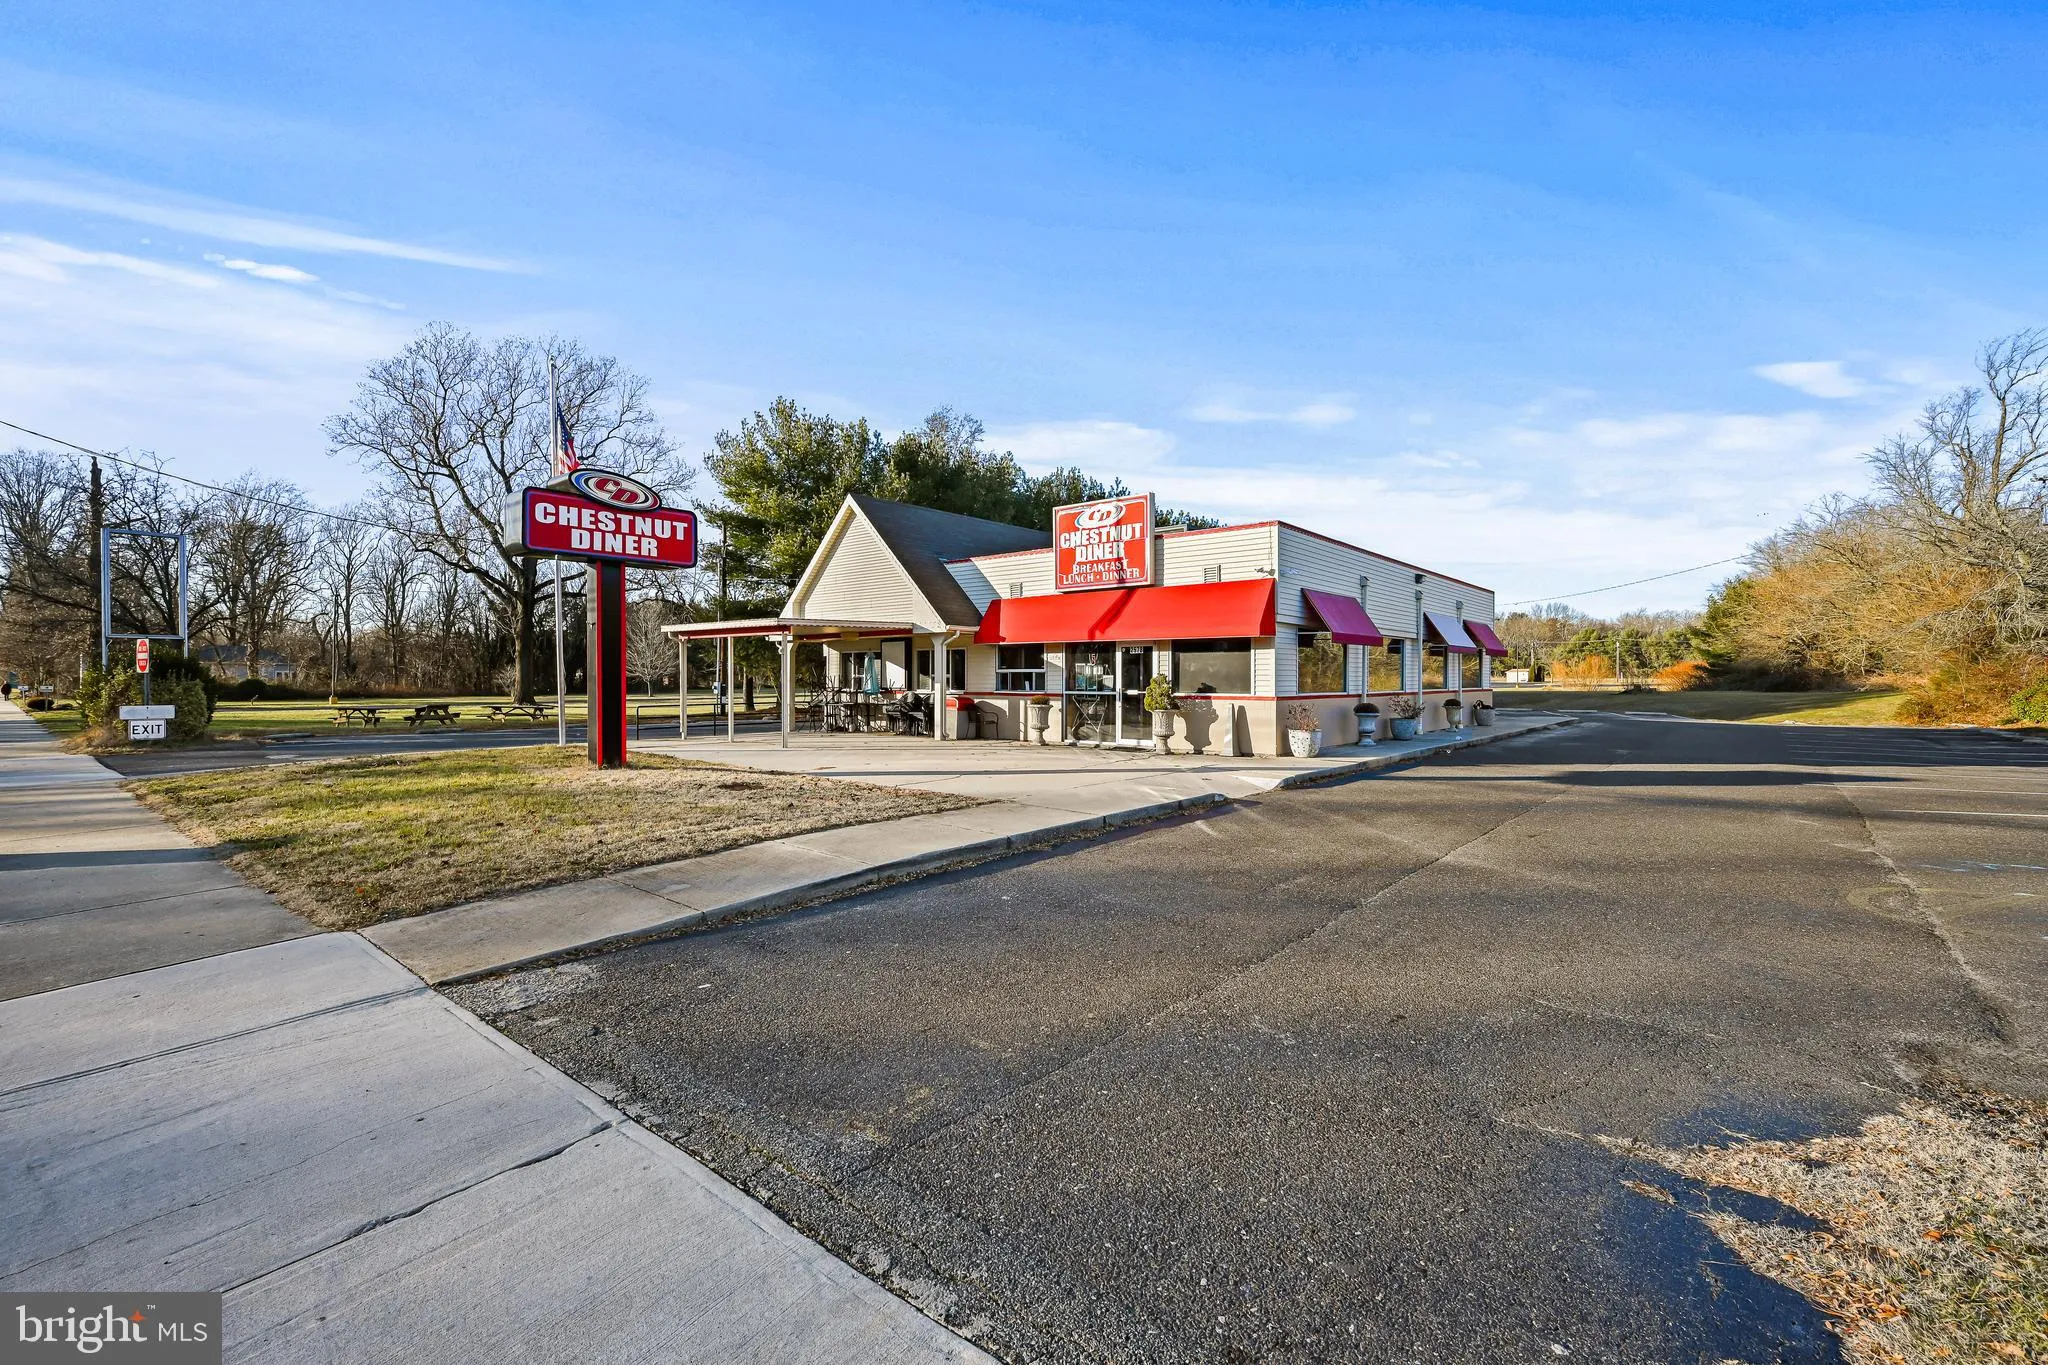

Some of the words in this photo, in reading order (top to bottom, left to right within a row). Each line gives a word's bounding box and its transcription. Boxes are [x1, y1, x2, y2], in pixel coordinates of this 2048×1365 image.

[534, 502, 688, 541] CHESTNUT
[571, 528, 658, 557] DINER
[1060, 523, 1142, 548] CHESTNUT
[1075, 541, 1125, 562] DINER
[1063, 573, 1094, 584] LUNCH
[1102, 568, 1140, 581] DINNER
[1073, 559, 1129, 574] BREAKFAST
[132, 724, 163, 735] EXIT
